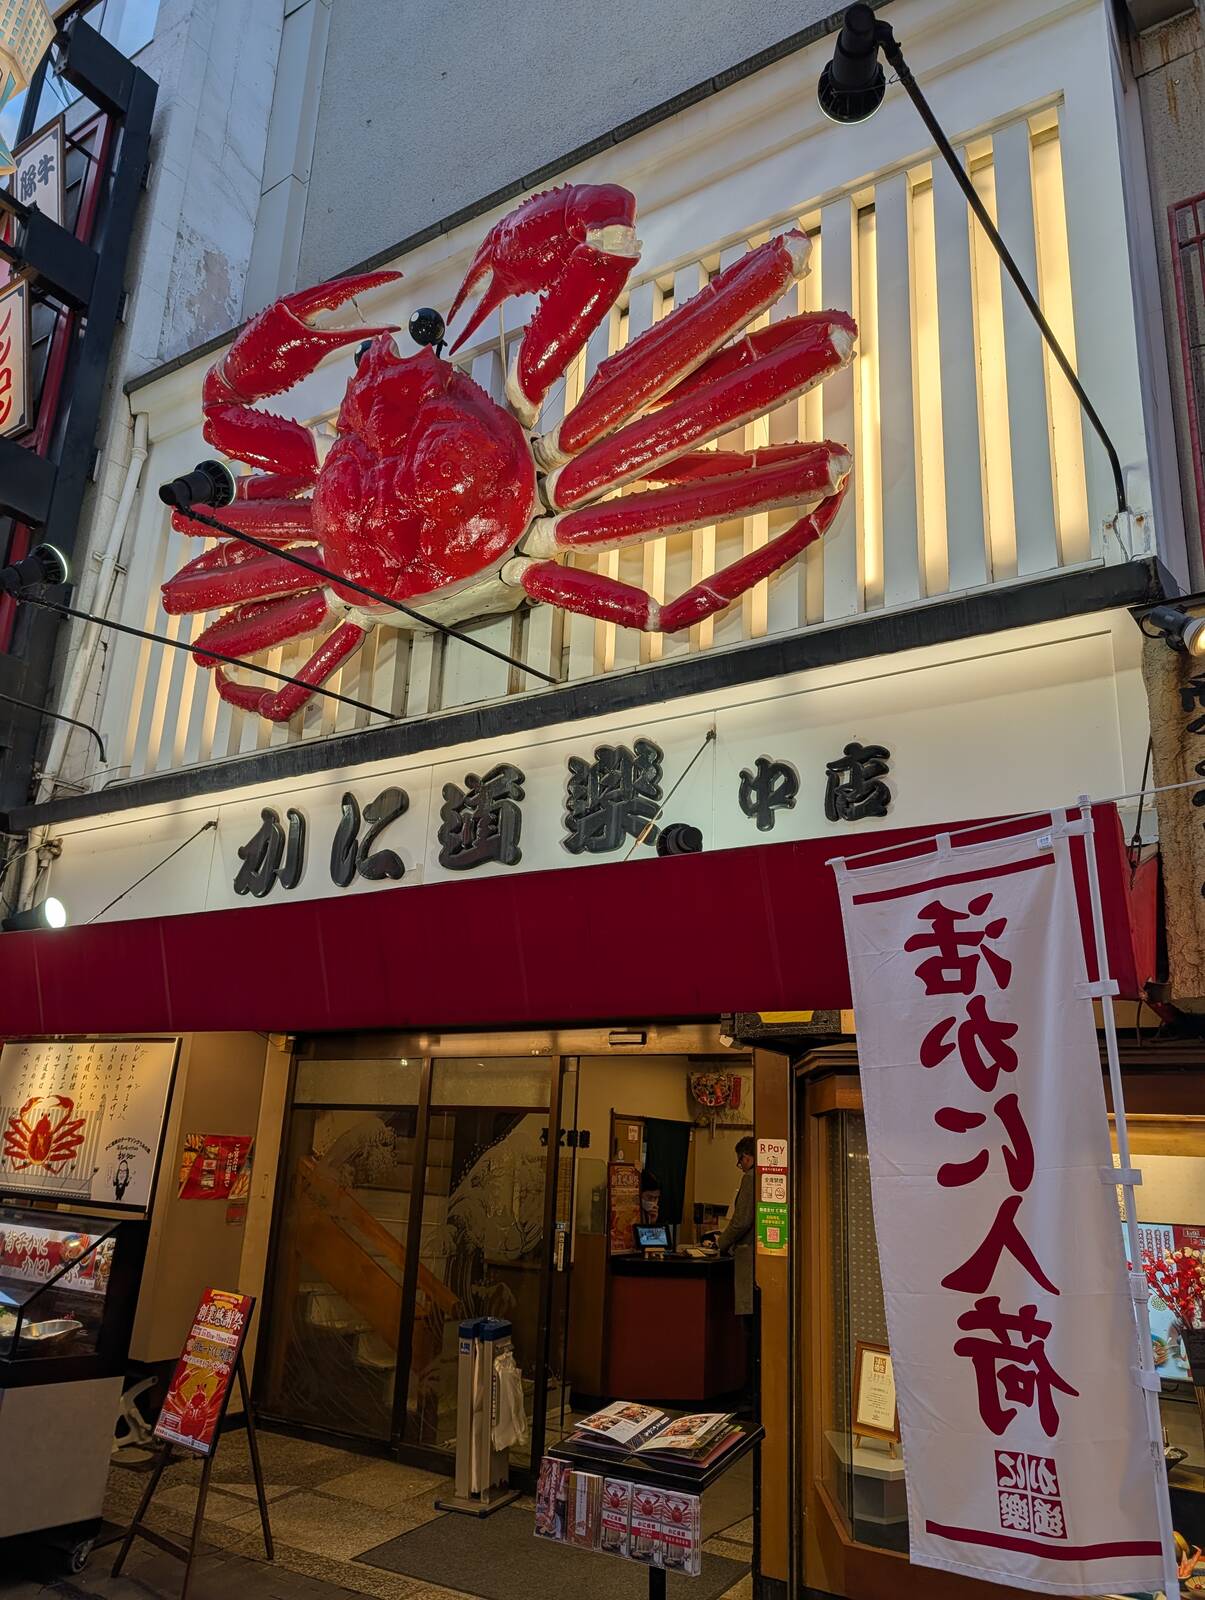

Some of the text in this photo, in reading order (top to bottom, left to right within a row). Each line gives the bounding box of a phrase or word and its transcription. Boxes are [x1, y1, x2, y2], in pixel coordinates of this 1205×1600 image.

[738, 743, 891, 831] 中店
[760, 1144, 785, 1155] R Pay
